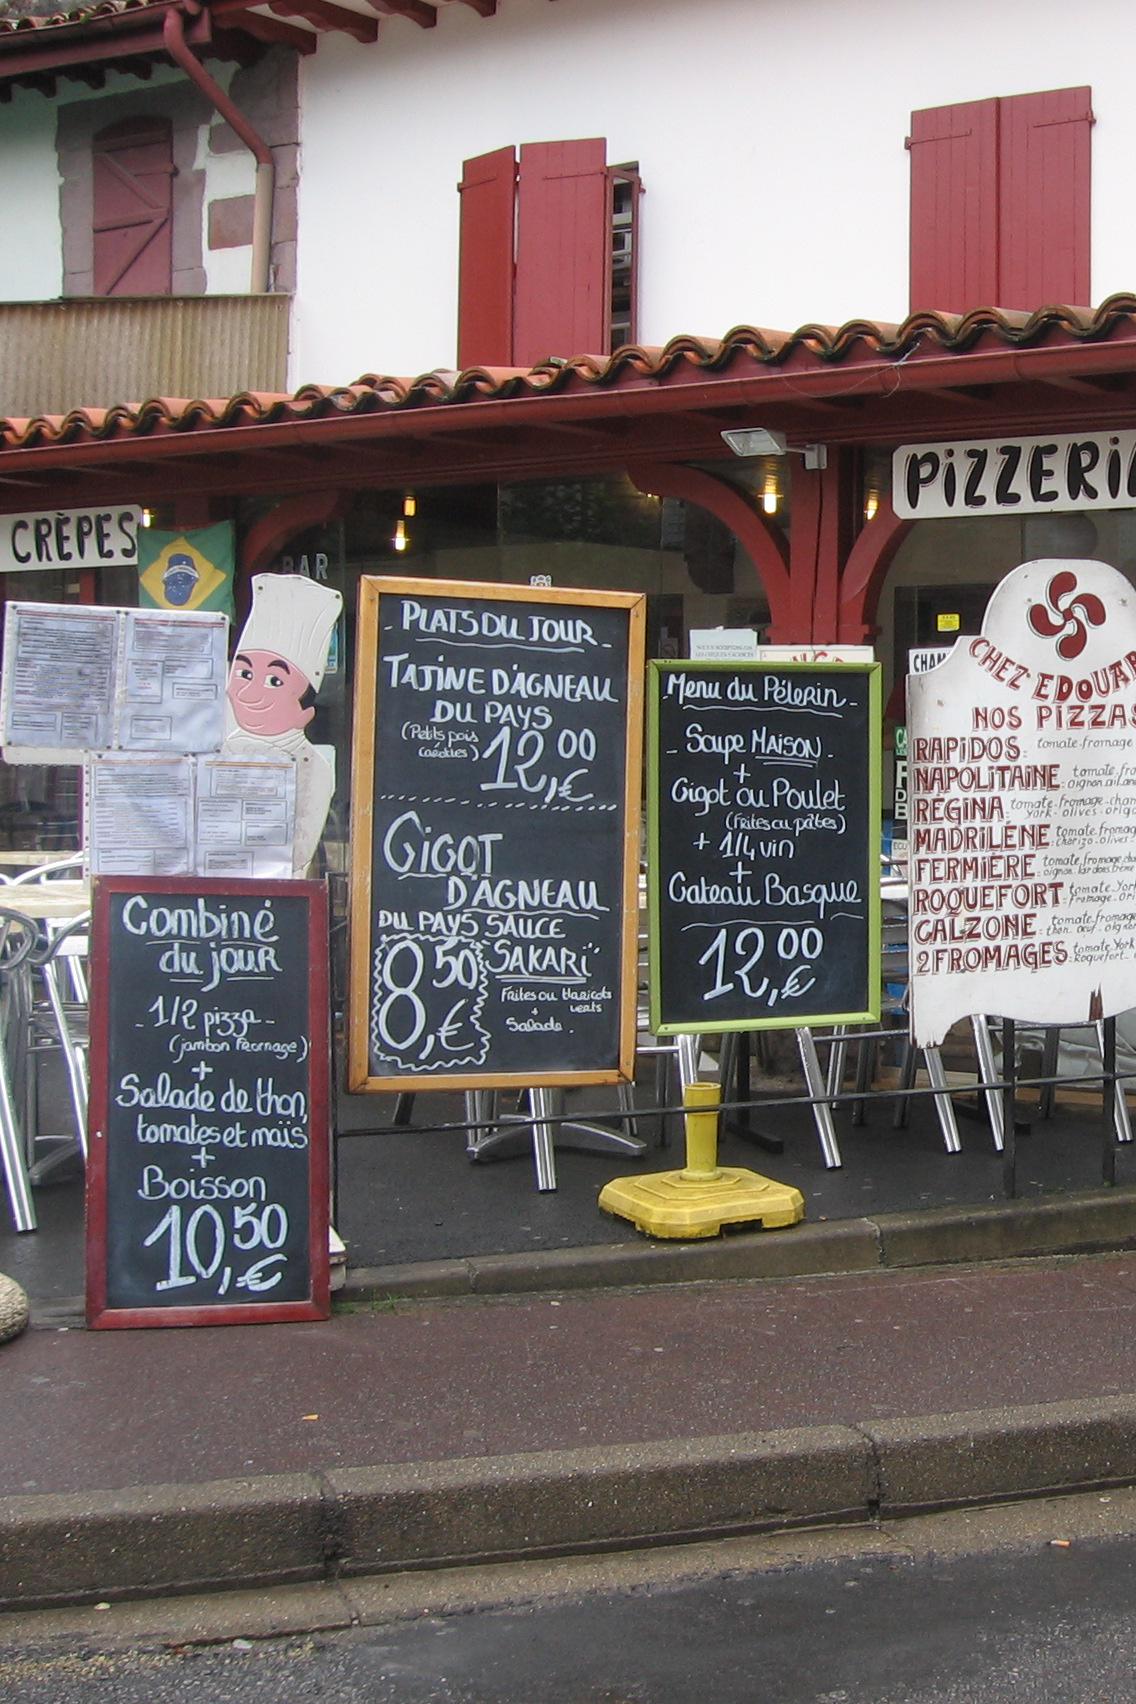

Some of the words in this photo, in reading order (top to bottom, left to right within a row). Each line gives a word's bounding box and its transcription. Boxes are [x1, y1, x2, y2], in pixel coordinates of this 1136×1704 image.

[401, 600, 480, 637] PLATS
[481, 611, 526, 641] DU
[528, 615, 599, 647] JOUR
[968, 636, 1032, 691] CHEZ
[491, 663, 620, 703] D'AGNEAU
[666, 673, 723, 705] Menu
[727, 676, 758, 702] du
[429, 699, 479, 724] DU
[484, 701, 554, 731] PAYS
[971, 706, 1023, 731] NOS
[686, 723, 748, 765] Soupe
[671, 776, 733, 817] Gigot
[736, 788, 770, 808] ou
[772, 777, 847, 812] Poulet
[760, 839, 795, 859] vin
[669, 871, 762, 907] Gateau
[765, 872, 864, 920] Basque
[912, 881, 1065, 917] ROQUEFORT
[122, 895, 280, 942] Combiné
[378, 909, 415, 931] DU
[418, 910, 480, 937] PAYS
[484, 914, 567, 939] SAUCE
[914, 912, 1038, 946] CALZONE
[158, 943, 204, 975] du
[538, 990, 559, 1001] ou
[203, 1007, 262, 1037] pizza
[115, 1071, 216, 1113] Salade
[221, 1078, 254, 1113] de
[136, 1113, 221, 1146] tomates
[223, 1122, 249, 1148] et
[137, 1164, 267, 1202] Boisson
